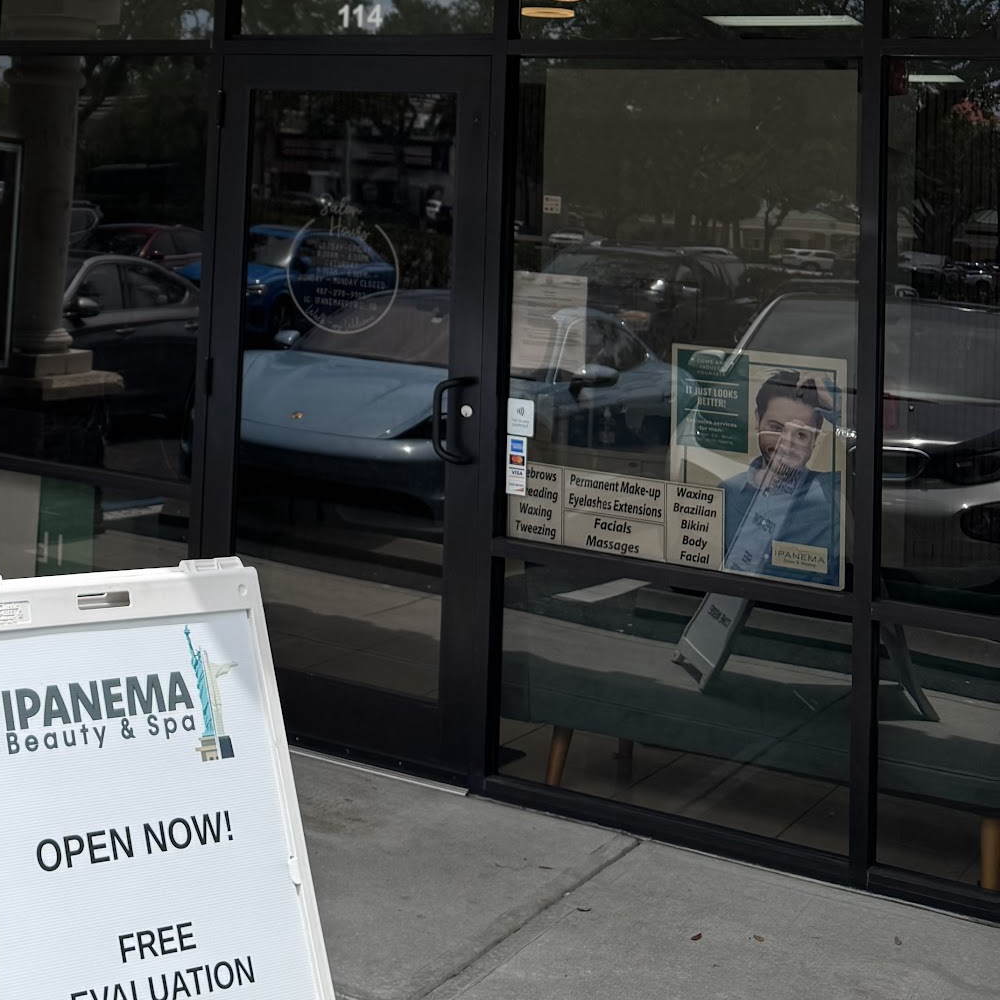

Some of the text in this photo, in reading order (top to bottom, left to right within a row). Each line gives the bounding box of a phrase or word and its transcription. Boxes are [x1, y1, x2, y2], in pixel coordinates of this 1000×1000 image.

[338, 3, 383, 29] 114
[694, 386, 712, 396] JUST
[713, 388, 738, 399] LOOKS
[697, 397, 727, 408] BETTER!
[526, 466, 557, 482] ebrows
[526, 487, 558, 503] reading
[569, 473, 661, 501] Permanent Make-up
[676, 487, 714, 503] Waxing
[519, 502, 552, 520] Waxing
[568, 493, 662, 518] Eyelashes Extensions
[673, 502, 717, 518] Brazilian
[515, 520, 556, 540] Tweezing
[593, 517, 632, 534] Facials
[680, 519, 709, 533] Bikini
[586, 535, 640, 554] Massages
[682, 535, 707, 550] Body
[679, 551, 710, 564] Facial
[774, 549, 825, 564] IPANEMA
[1, 671, 194, 731] IPANEMA
[6, 714, 196, 754] Beauty & Spa
[36, 810, 234, 872] OPEN NOW!
[118, 921, 197, 964] FREE
